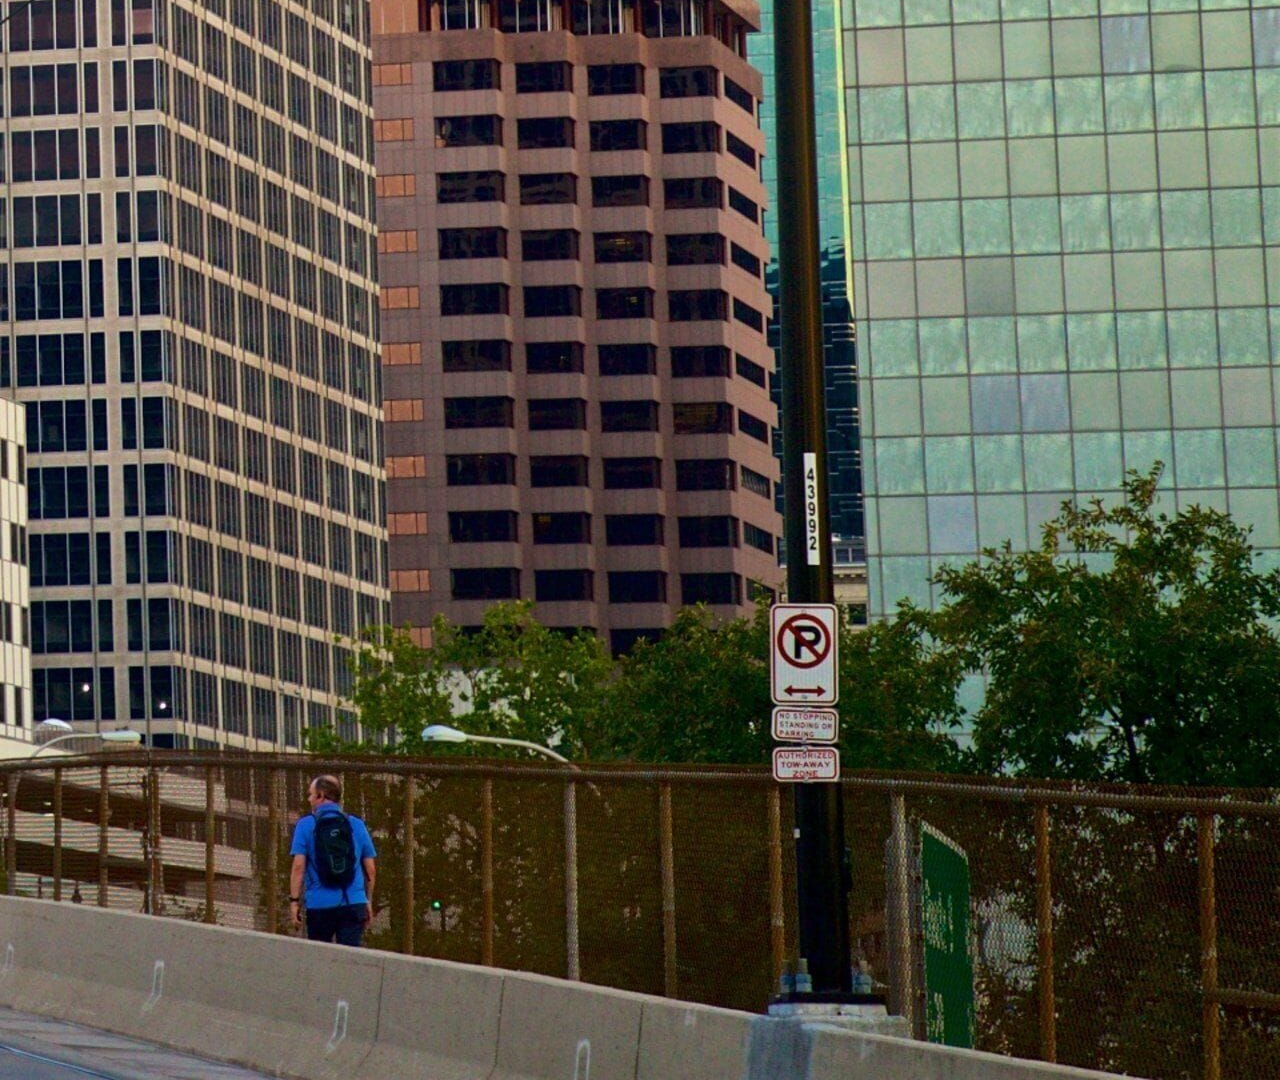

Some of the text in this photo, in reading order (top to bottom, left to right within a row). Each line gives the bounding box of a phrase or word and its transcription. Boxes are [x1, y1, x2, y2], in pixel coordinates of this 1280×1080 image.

[806, 467, 817, 550] 43992
[794, 625, 821, 660] P
[793, 713, 833, 721] STOPPING
[779, 721, 819, 729] STANDING
[779, 730, 815, 738] PARKING
